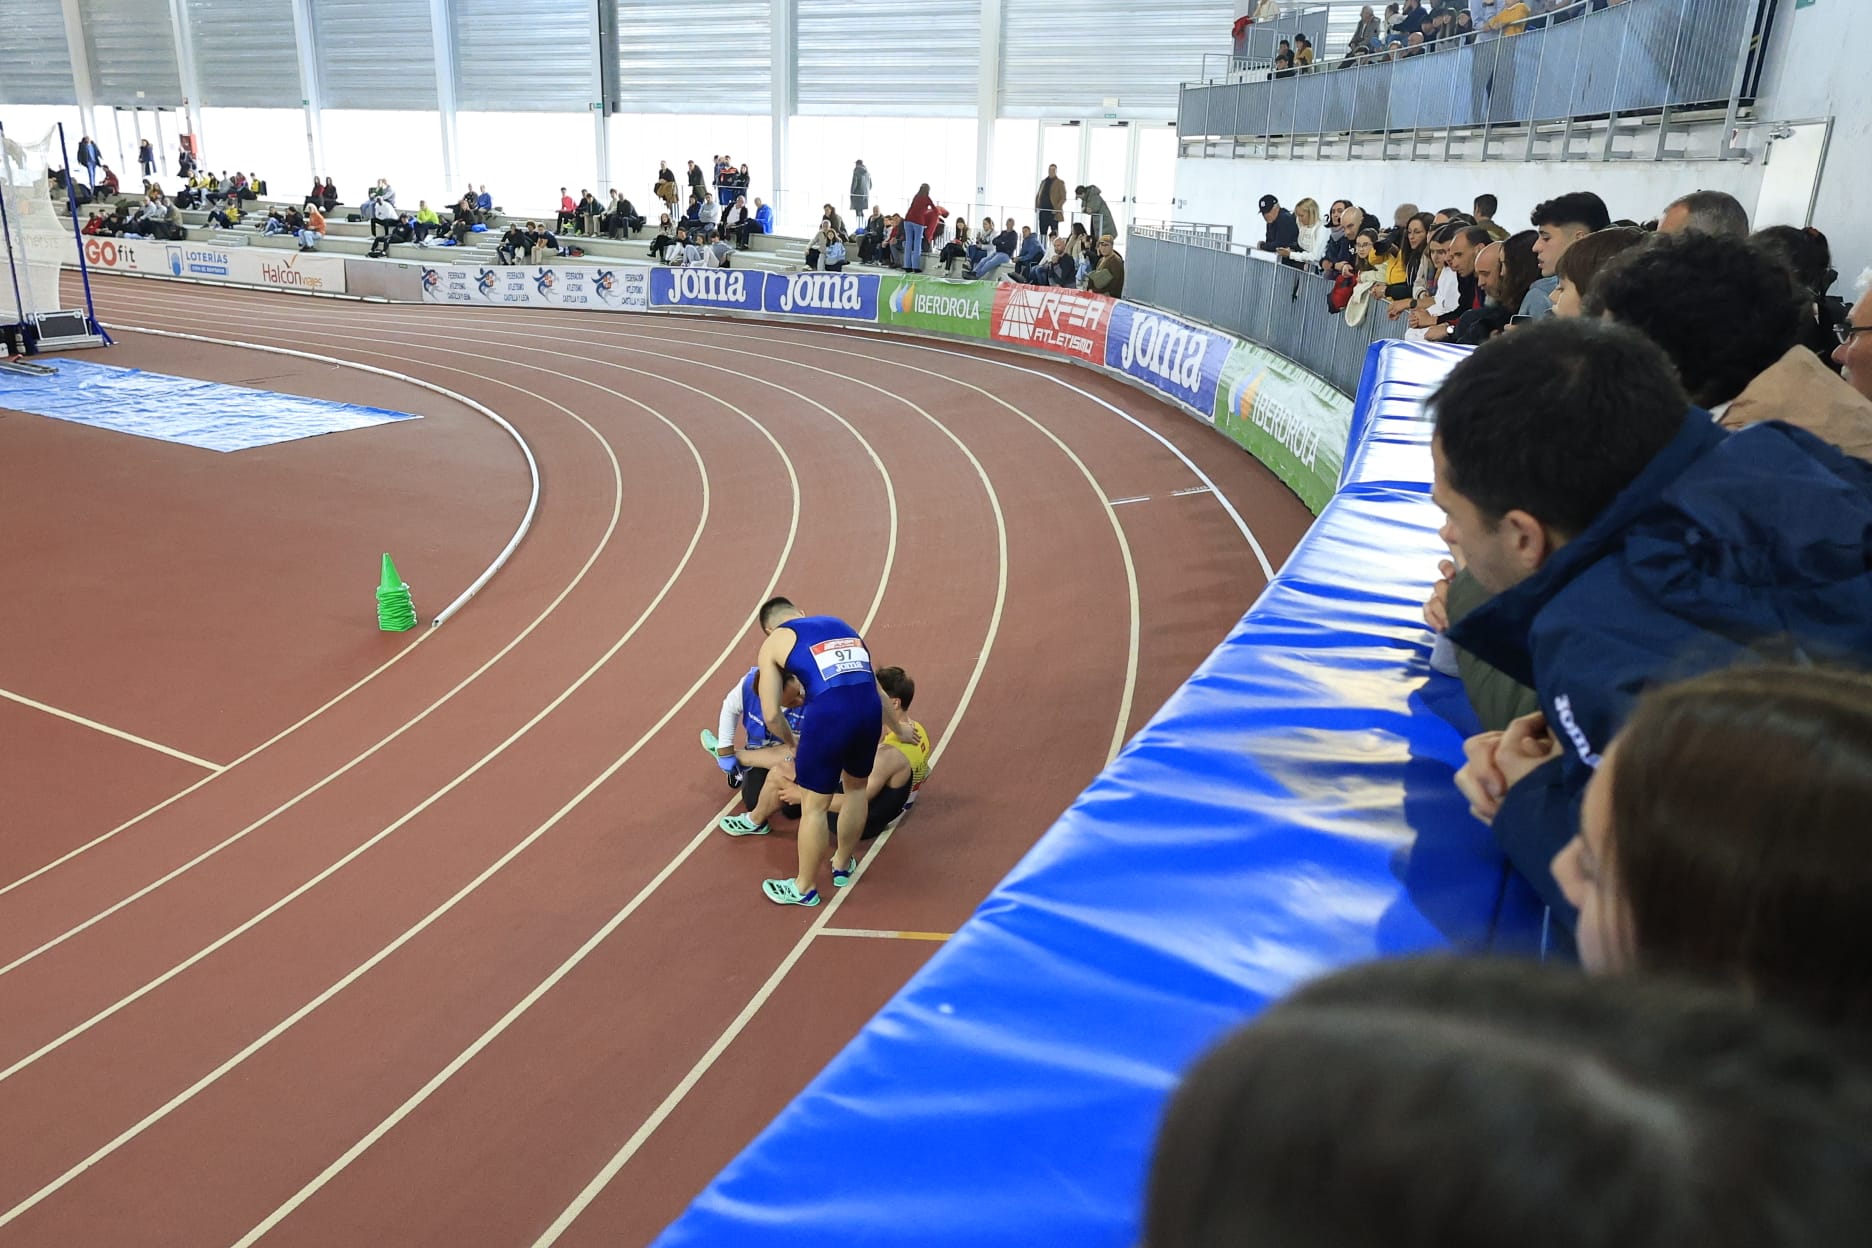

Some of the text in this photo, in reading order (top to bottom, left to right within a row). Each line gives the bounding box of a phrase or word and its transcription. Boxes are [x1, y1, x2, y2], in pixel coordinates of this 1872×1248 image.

[185, 250, 228, 264] LOTERÍAS
[914, 293, 980, 320] IBERDROLA
[1038, 291, 1106, 330] RFEA
[1033, 327, 1094, 355] ATLETISMO
[1252, 391, 1321, 473] IBERDROLA
[835, 649, 852, 662] 97
